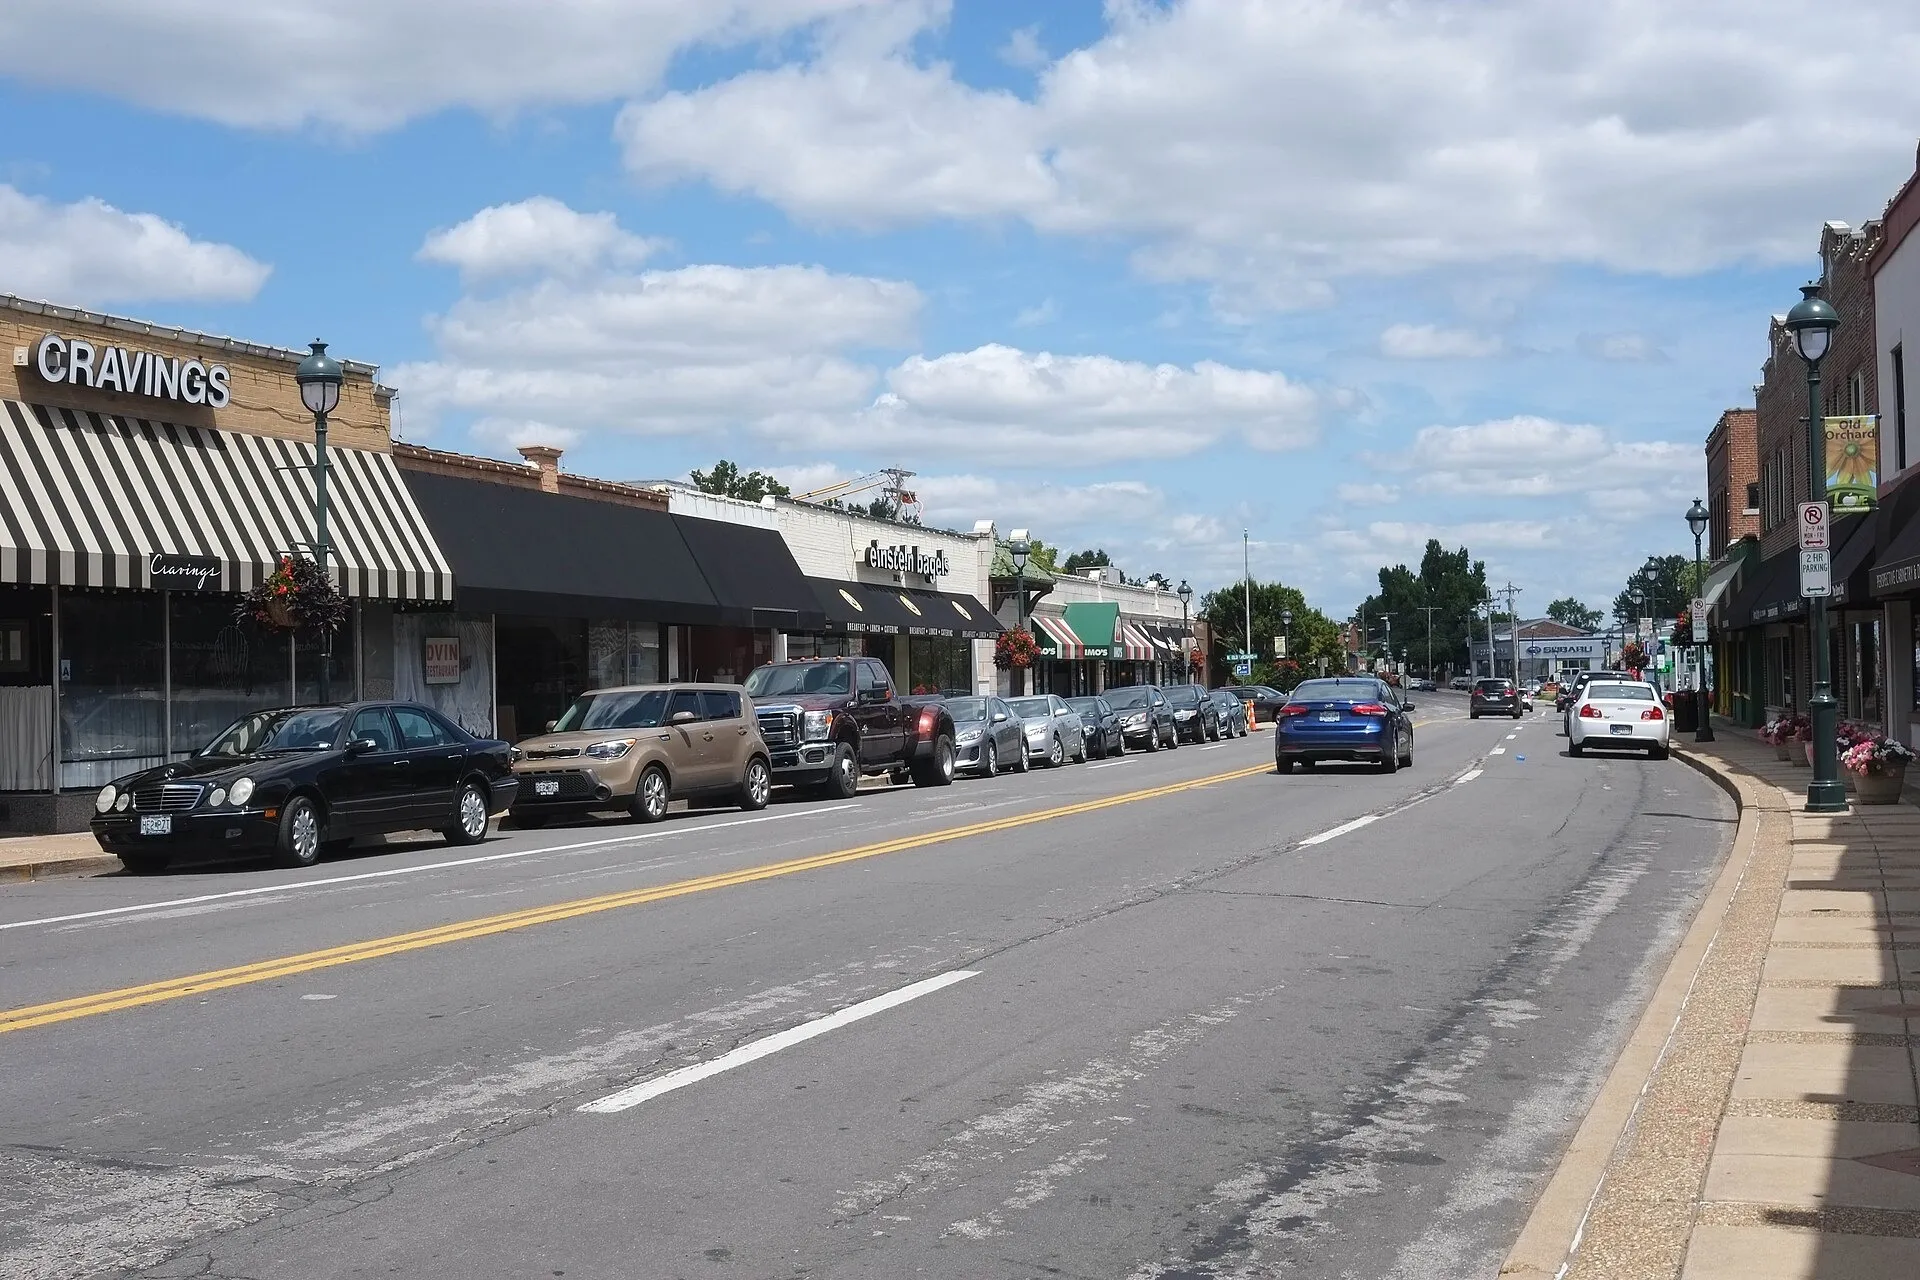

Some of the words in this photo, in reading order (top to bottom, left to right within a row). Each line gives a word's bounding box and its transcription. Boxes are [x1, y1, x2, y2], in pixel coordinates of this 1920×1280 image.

[37, 334, 231, 408] CRAVINGS
[1839, 420, 1861, 430] Old
[1826, 428, 1875, 440] Orchard
[870, 540, 914, 572] einstein
[917, 545, 950, 584] bagels
[1806, 553, 1812, 562] 2
[1813, 553, 1824, 562] HR
[150, 553, 221, 590] Cravings
[1803, 563, 1828, 574] PARKING
[847, 622, 866, 632] BREAKFAST
[869, 624, 881, 633] LUNCH
[884, 625, 899, 634] CATERING
[909, 626, 925, 635] BREAKFAST
[928, 627, 938, 636] LUNCH
[941, 628, 953, 637] CATERING
[1084, 648, 1108, 656] IMO'S
[1543, 645, 1593, 654] SUBARU
[62, 667, 70, 677] A
